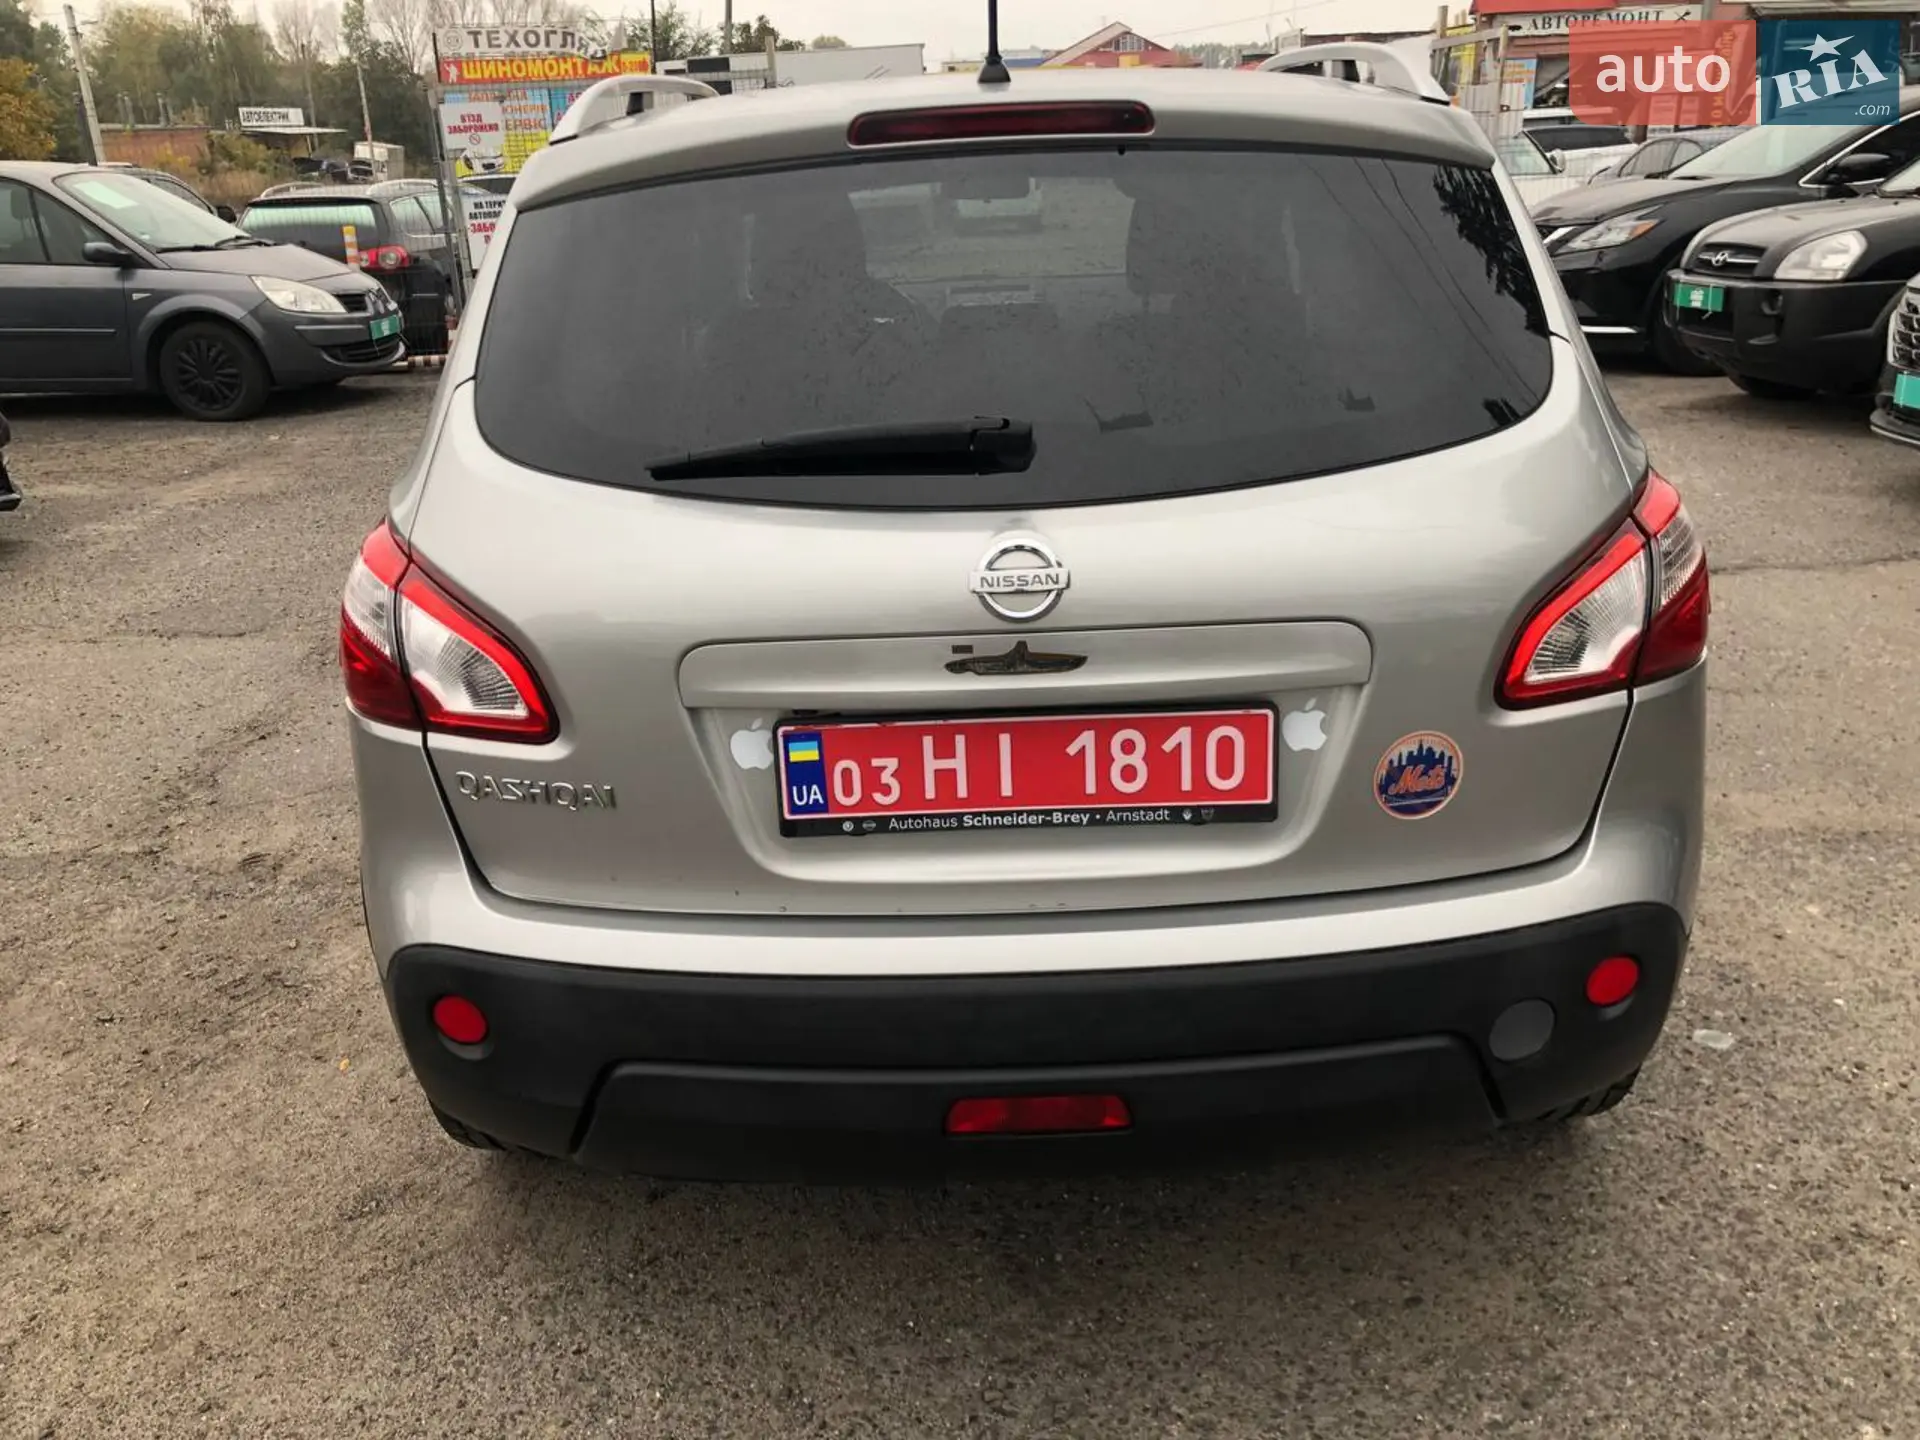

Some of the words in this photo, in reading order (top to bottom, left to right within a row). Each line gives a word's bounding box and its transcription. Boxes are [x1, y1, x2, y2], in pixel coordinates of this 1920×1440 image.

[1527, 10, 1664, 31] АВТОРЕМОНТ
[461, 52, 621, 79] ШИНОМОНТАЖ
[503, 118, 548, 131] ЕРВІС
[980, 573, 1060, 588] NISSAN
[833, 757, 901, 807] 03
[1065, 725, 1245, 795] 1810
[455, 771, 617, 811] QASHQAI
[792, 784, 824, 806] UA
[888, 817, 958, 831] Autohaus
[963, 810, 1091, 828] Schneider-Brey
[1105, 808, 1171, 823] Arnstadt
